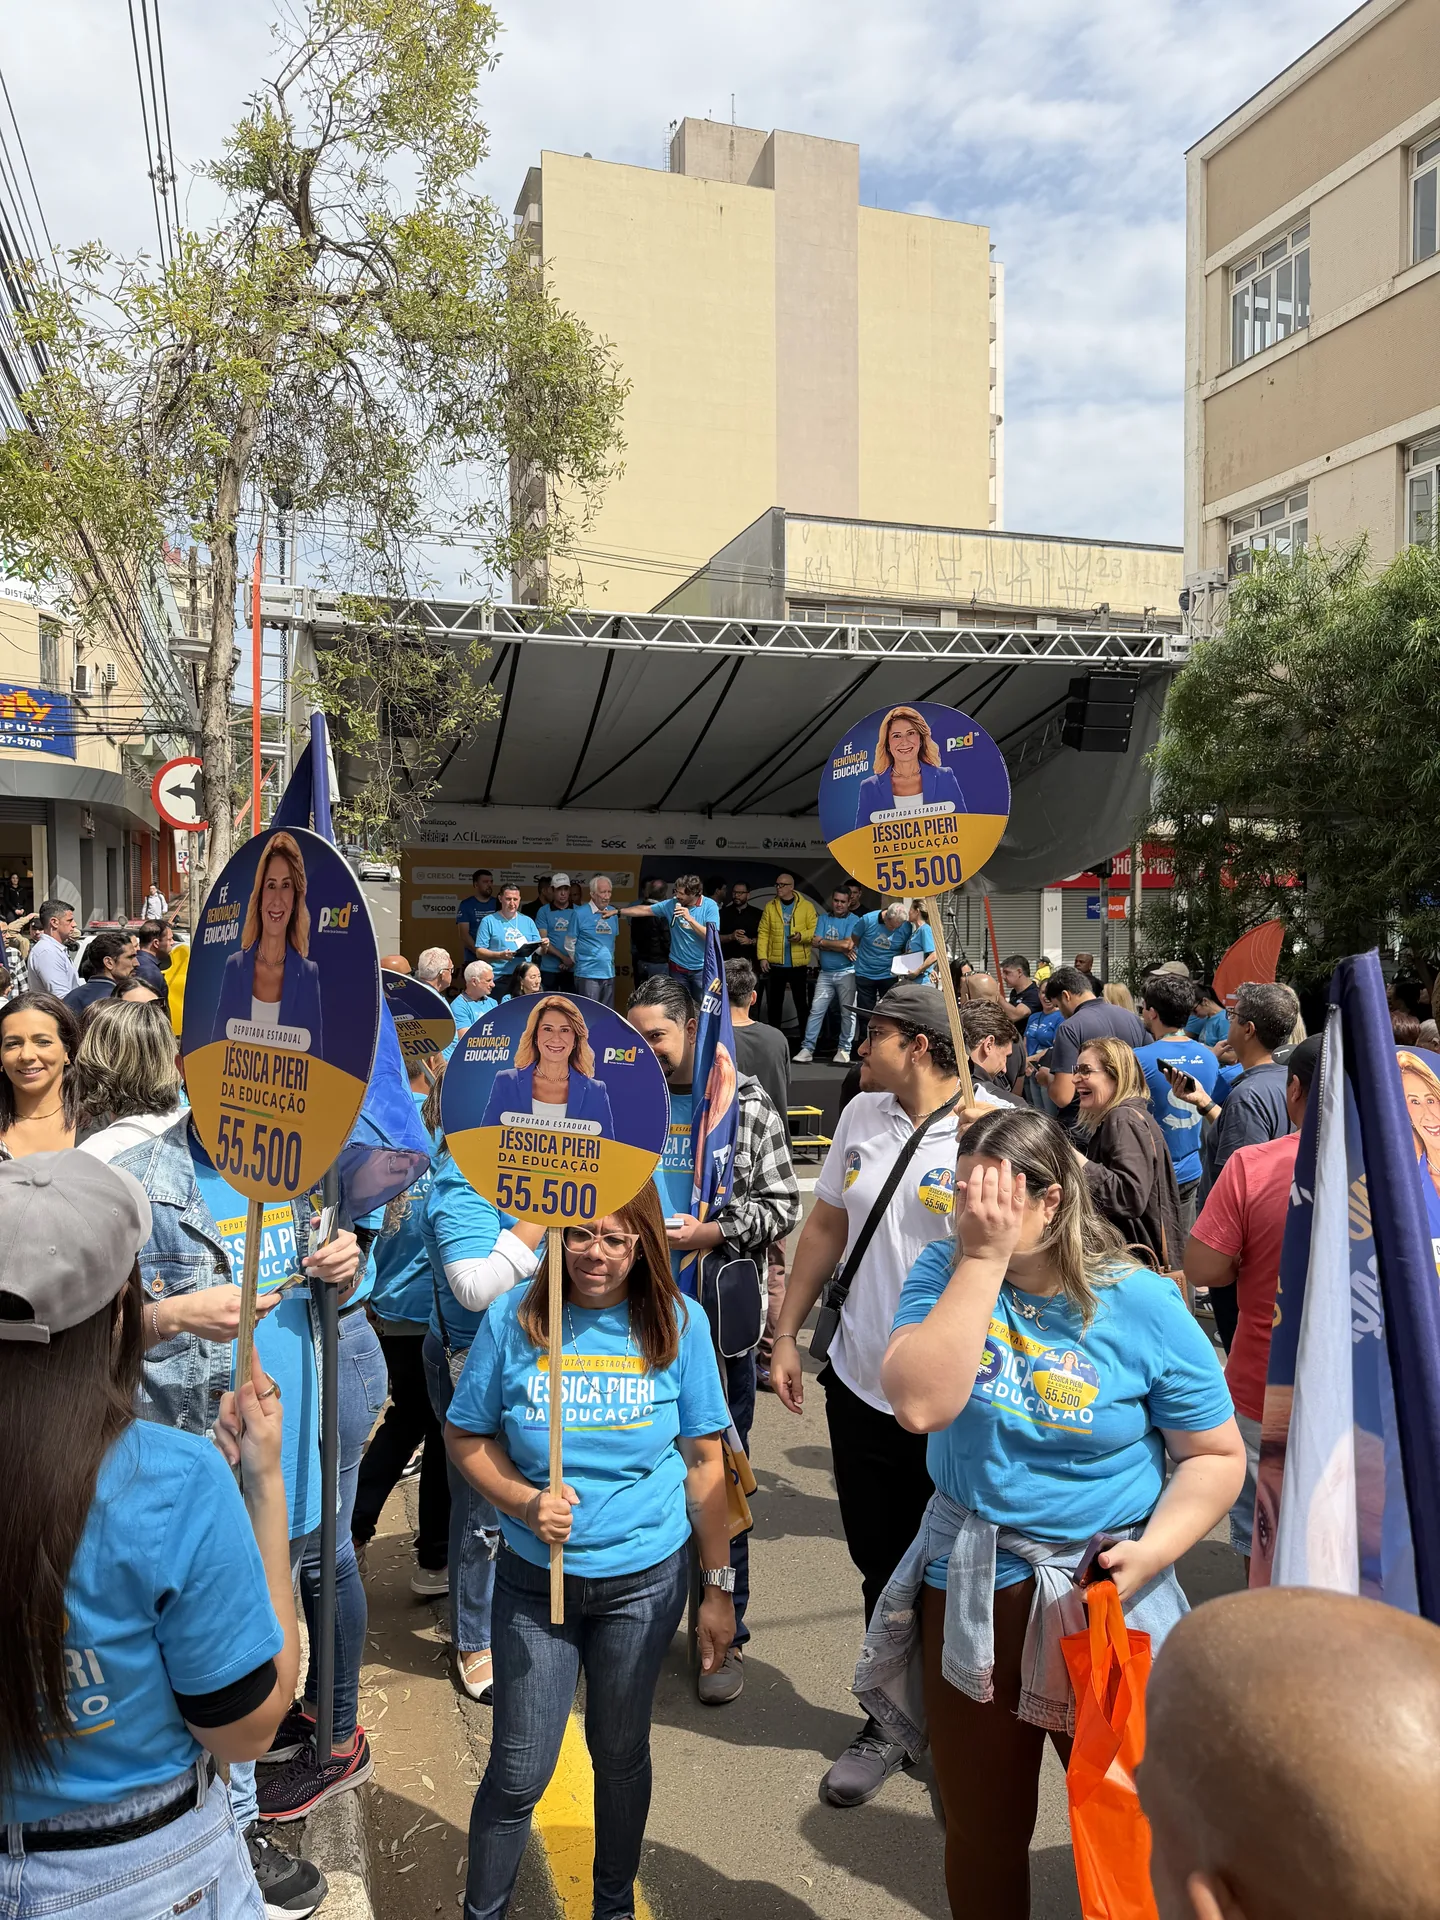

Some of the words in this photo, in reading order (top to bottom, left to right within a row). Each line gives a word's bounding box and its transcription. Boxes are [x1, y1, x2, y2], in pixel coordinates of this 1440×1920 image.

[843, 741, 853, 755] FÉ
[946, 731, 974, 752] psd
[833, 750, 868, 768] RENOVAÇÃO
[832, 761, 869, 780] EDUCAÇÃO
[878, 809, 912, 820] DEPUTADA
[914, 805, 947, 815] ESTADUAL
[872, 822, 922, 843] JÉSSICA
[924, 816, 958, 836] PIERI
[773, 840, 806, 849] PARANÁ
[873, 844, 890, 854] DA
[893, 835, 959, 852] EDUCAÇÃO
[876, 853, 962, 892] 55.500
[218, 881, 230, 905] FÉ
[206, 900, 241, 924] RENOVAÇÃO
[318, 902, 352, 933] psd
[352, 904, 359, 913] 55
[431, 904, 456, 912] SICOOB
[1108, 904, 1123, 912] luga
[203, 920, 239, 946] EDUCAÇÃO
[233, 1024, 265, 1040] DEPUTADA
[267, 1029, 302, 1044] ESTADUAL
[397, 1020, 423, 1032] PIERI
[398, 1029, 427, 1038] CAÇÃO
[481, 1021, 495, 1036] FÉ
[402, 1037, 440, 1056] .500
[467, 1034, 511, 1049] RENOVAÇÃO
[464, 1046, 510, 1064] EDUCAÇÃO
[603, 1046, 637, 1064] psd
[222, 1042, 269, 1085] JÉSSICA
[272, 1054, 309, 1091] PIERI
[221, 1081, 235, 1099] DA
[239, 1086, 306, 1114] EDUCAÇÃO
[510, 1116, 550, 1127] DEPUTADA
[553, 1121, 591, 1132] ESTADUAL
[216, 1114, 303, 1192] 55.500
[499, 1127, 558, 1155] JÉSSICA
[561, 1137, 601, 1160] PIERI
[498, 1152, 516, 1164] DA
[522, 1154, 599, 1174] EDUCAÇÃO
[496, 1173, 597, 1220] 55.500
[263, 1210, 290, 1223] ESTADU
[606, 1376, 656, 1405] PIERI
[1045, 1387, 1080, 1408] 55.500
[525, 1407, 546, 1422] DA
[561, 1404, 654, 1424] DUCAÇÃO
